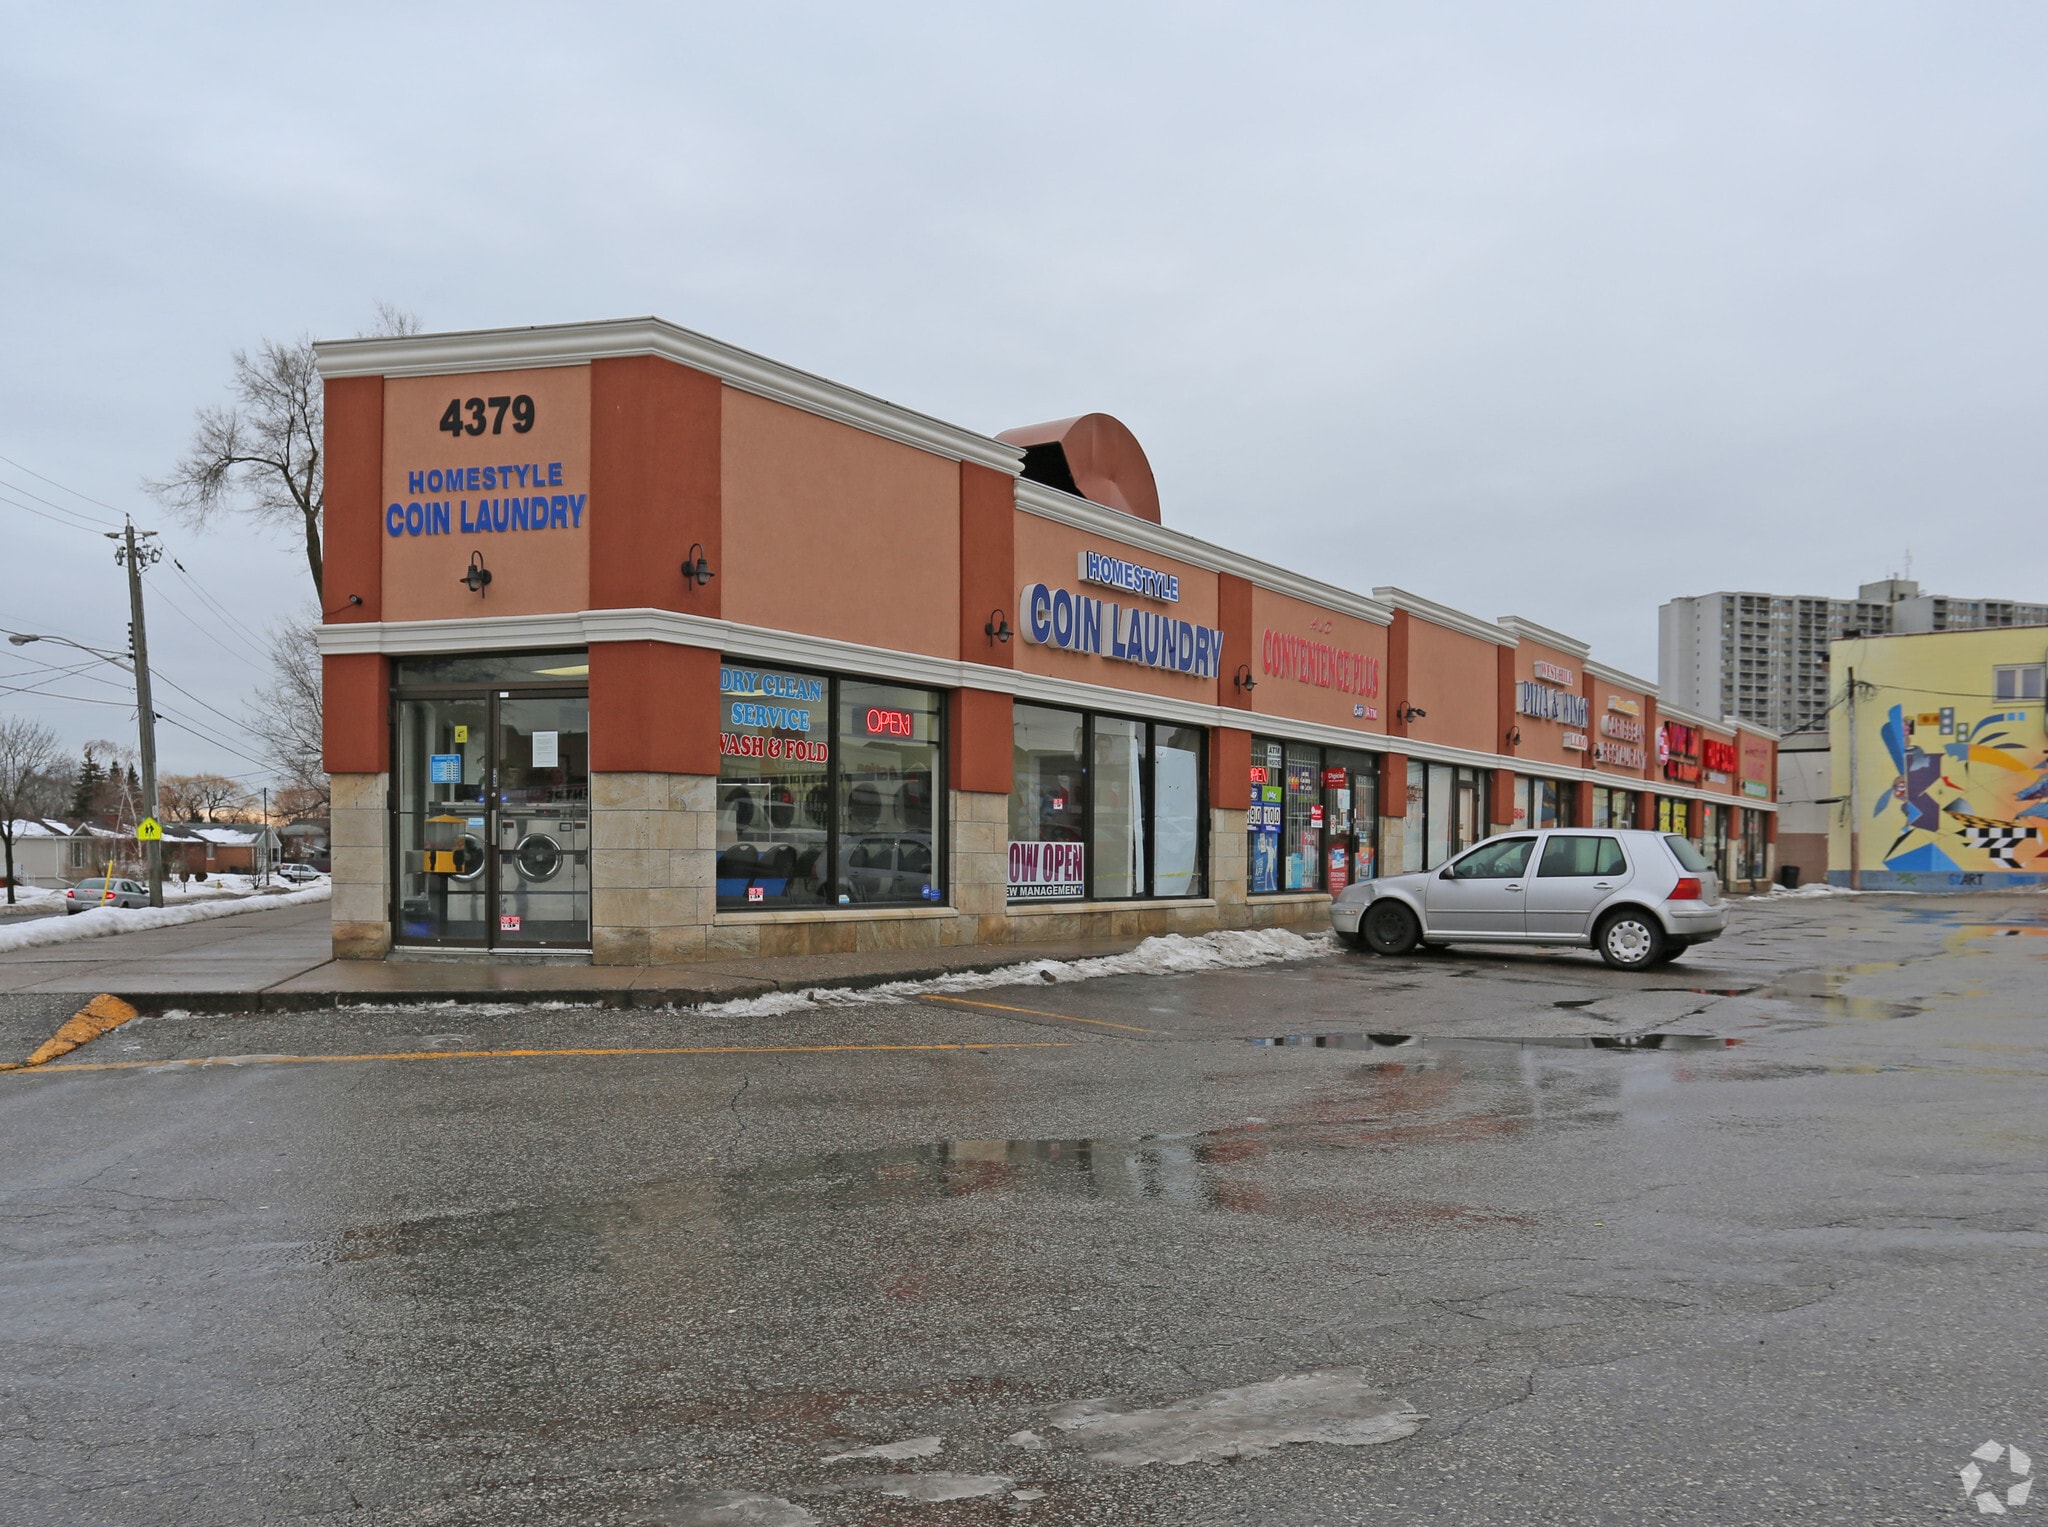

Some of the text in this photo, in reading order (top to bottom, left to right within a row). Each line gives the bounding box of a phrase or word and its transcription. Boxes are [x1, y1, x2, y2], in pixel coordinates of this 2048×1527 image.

[439, 394, 535, 437] 4379
[408, 462, 564, 494] HOMESTYLE
[386, 493, 587, 537] COIN LAUNDRY
[1086, 551, 1180, 603] HOMESTYLE
[1028, 583, 1224, 679] COIN LAUNDRY
[1262, 628, 1379, 700] CONVENIENCE PLUS
[720, 668, 822, 702] DRY CLEAN
[731, 702, 811, 732] SERVICE
[1523, 680, 1549, 718] PIZZA
[1552, 689, 1559, 719] &
[1563, 693, 1589, 728] WINGS
[866, 708, 913, 737] OPEN
[1608, 715, 1645, 743] CARIBBEAN
[767, 738, 782, 758] &
[785, 740, 828, 763] FOLD
[1250, 767, 1268, 782] PEN
[1009, 842, 1083, 883] OW OPEN
[1019, 884, 1083, 896] MANAGEMENT
